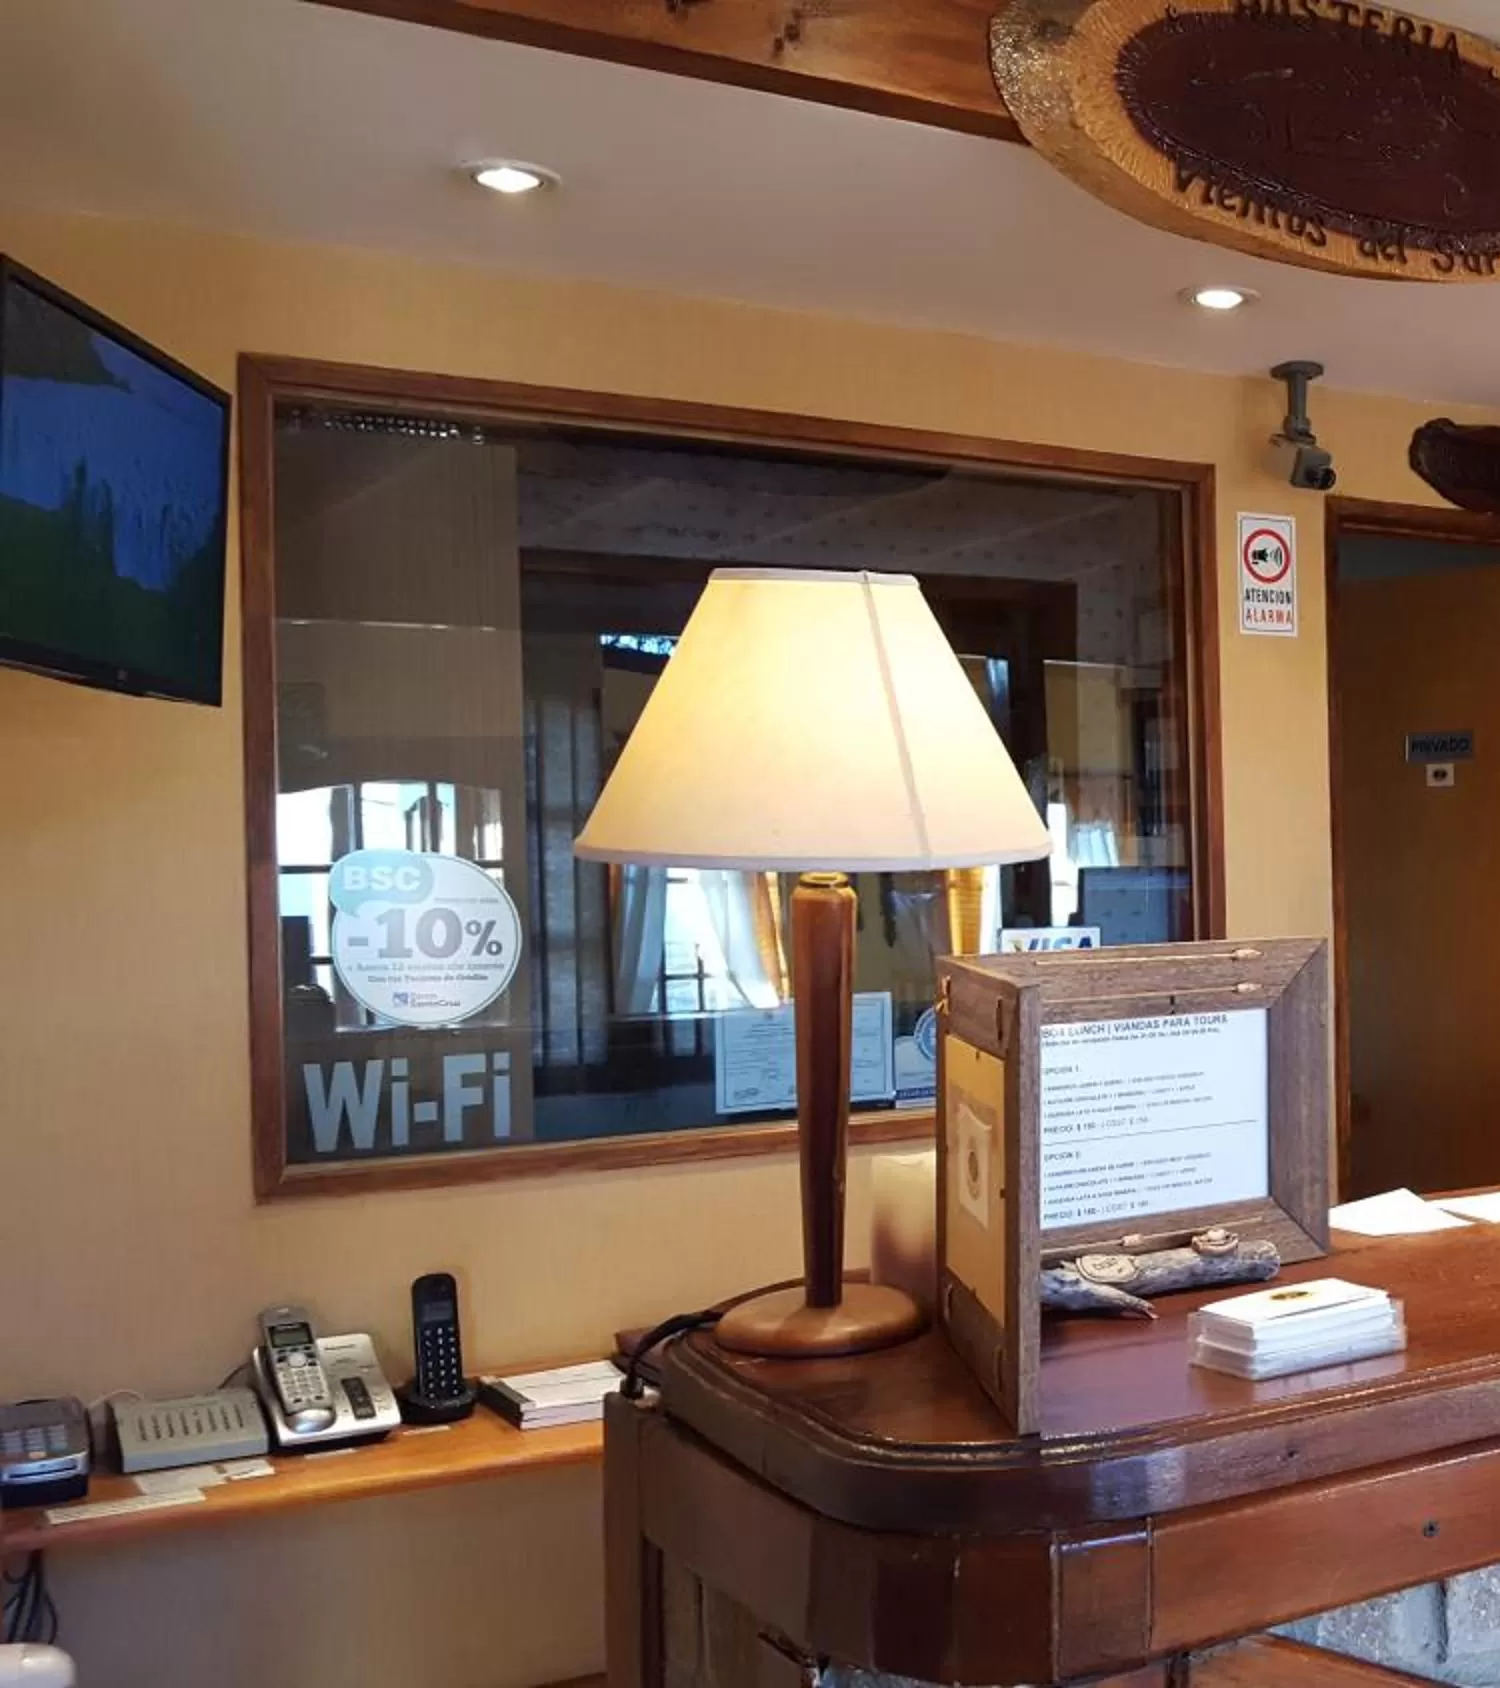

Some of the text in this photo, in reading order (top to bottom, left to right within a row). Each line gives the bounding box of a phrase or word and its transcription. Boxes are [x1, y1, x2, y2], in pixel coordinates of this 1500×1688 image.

[1245, 587, 1292, 604] ATENCION
[1246, 608, 1293, 624] ALARMA
[342, 865, 421, 892] BSC
[347, 907, 503, 959] -10%
[1009, 936, 1093, 951] VISA
[1113, 1018, 1160, 1033] VIANDAS
[1162, 1016, 1191, 1029] PARA
[1194, 1013, 1228, 1026] TOURS
[303, 1052, 512, 1153] Wi-Fi
